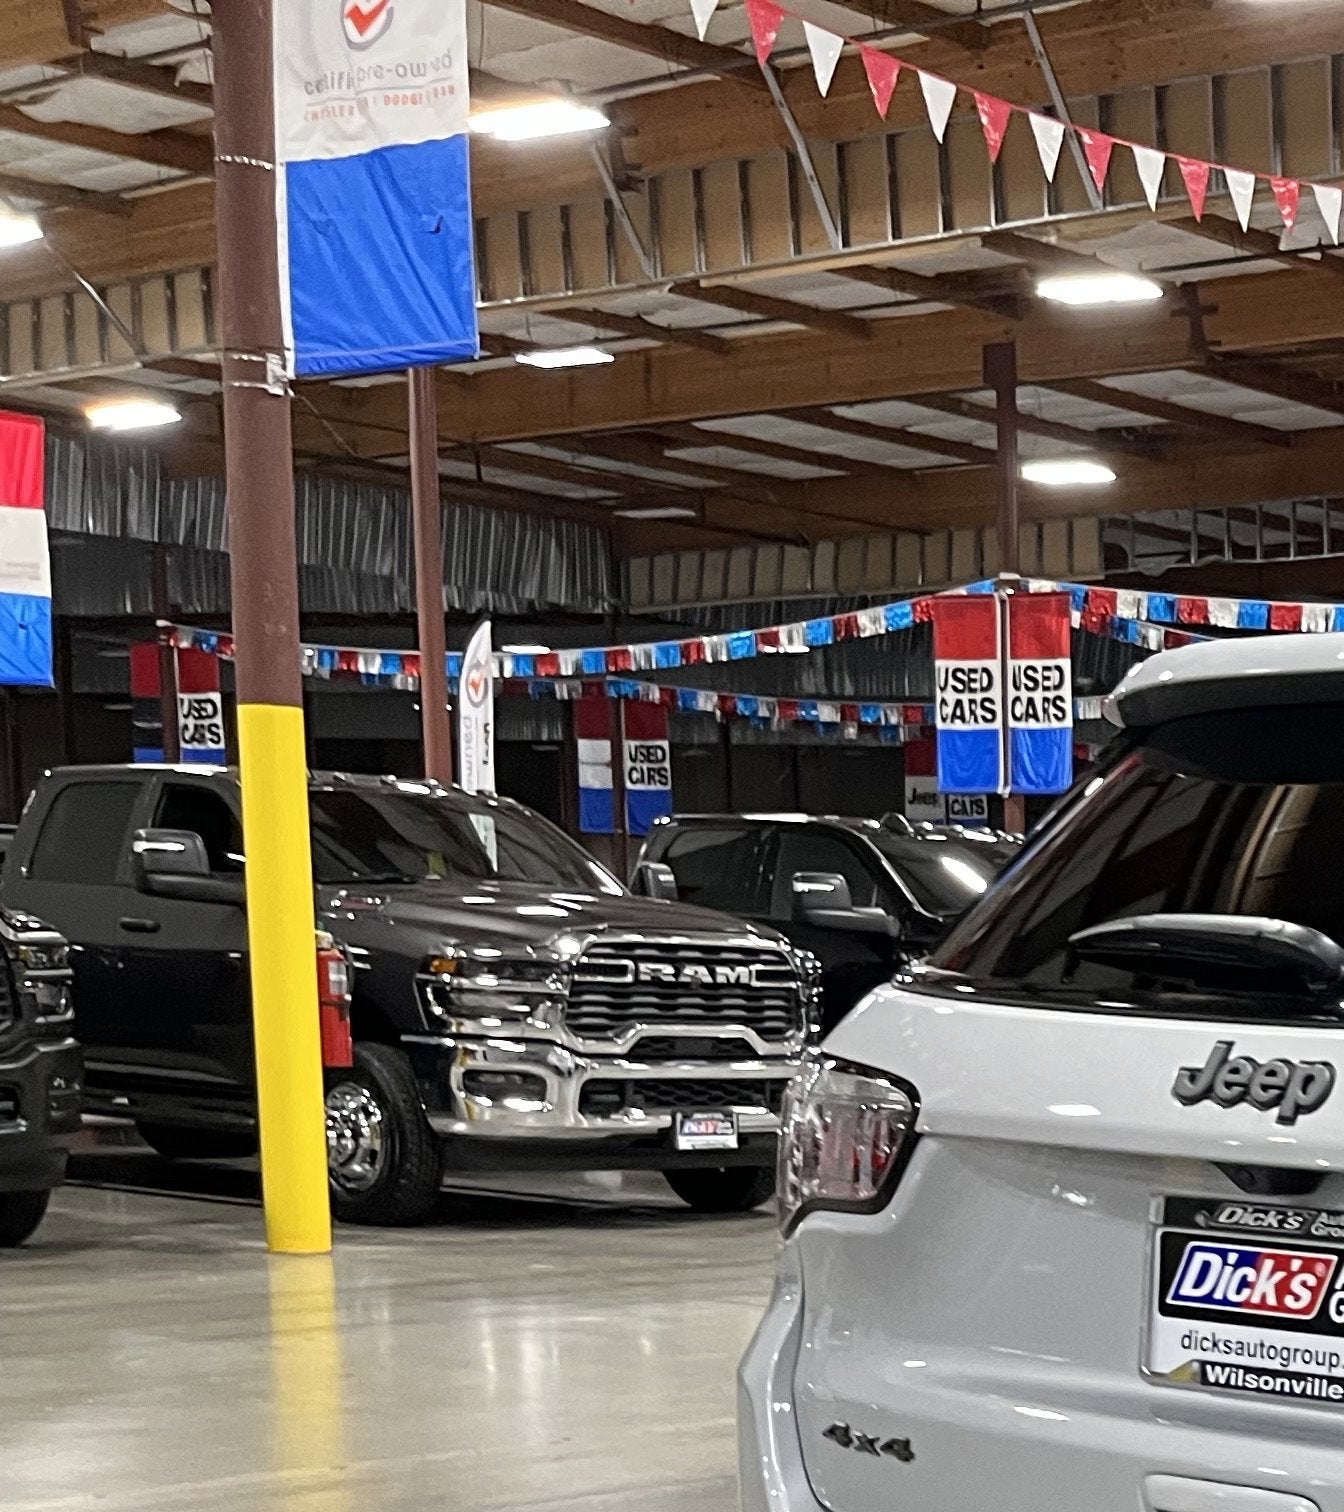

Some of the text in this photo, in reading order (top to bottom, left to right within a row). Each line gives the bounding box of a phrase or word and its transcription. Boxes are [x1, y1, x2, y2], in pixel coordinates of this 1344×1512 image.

[938, 666, 994, 694] USED
[1012, 665, 1065, 692] USED
[939, 697, 997, 724] CARS
[1011, 696, 1066, 723] CARS
[628, 744, 666, 764] USED
[638, 961, 750, 985] RAM
[1171, 1040, 1337, 1126] Jeep
[1217, 1205, 1303, 1230] Dick's
[1178, 1251, 1317, 1310] Dick's
[1205, 1364, 1344, 1400] Wilsonville
[821, 1422, 916, 1463] 4x4
